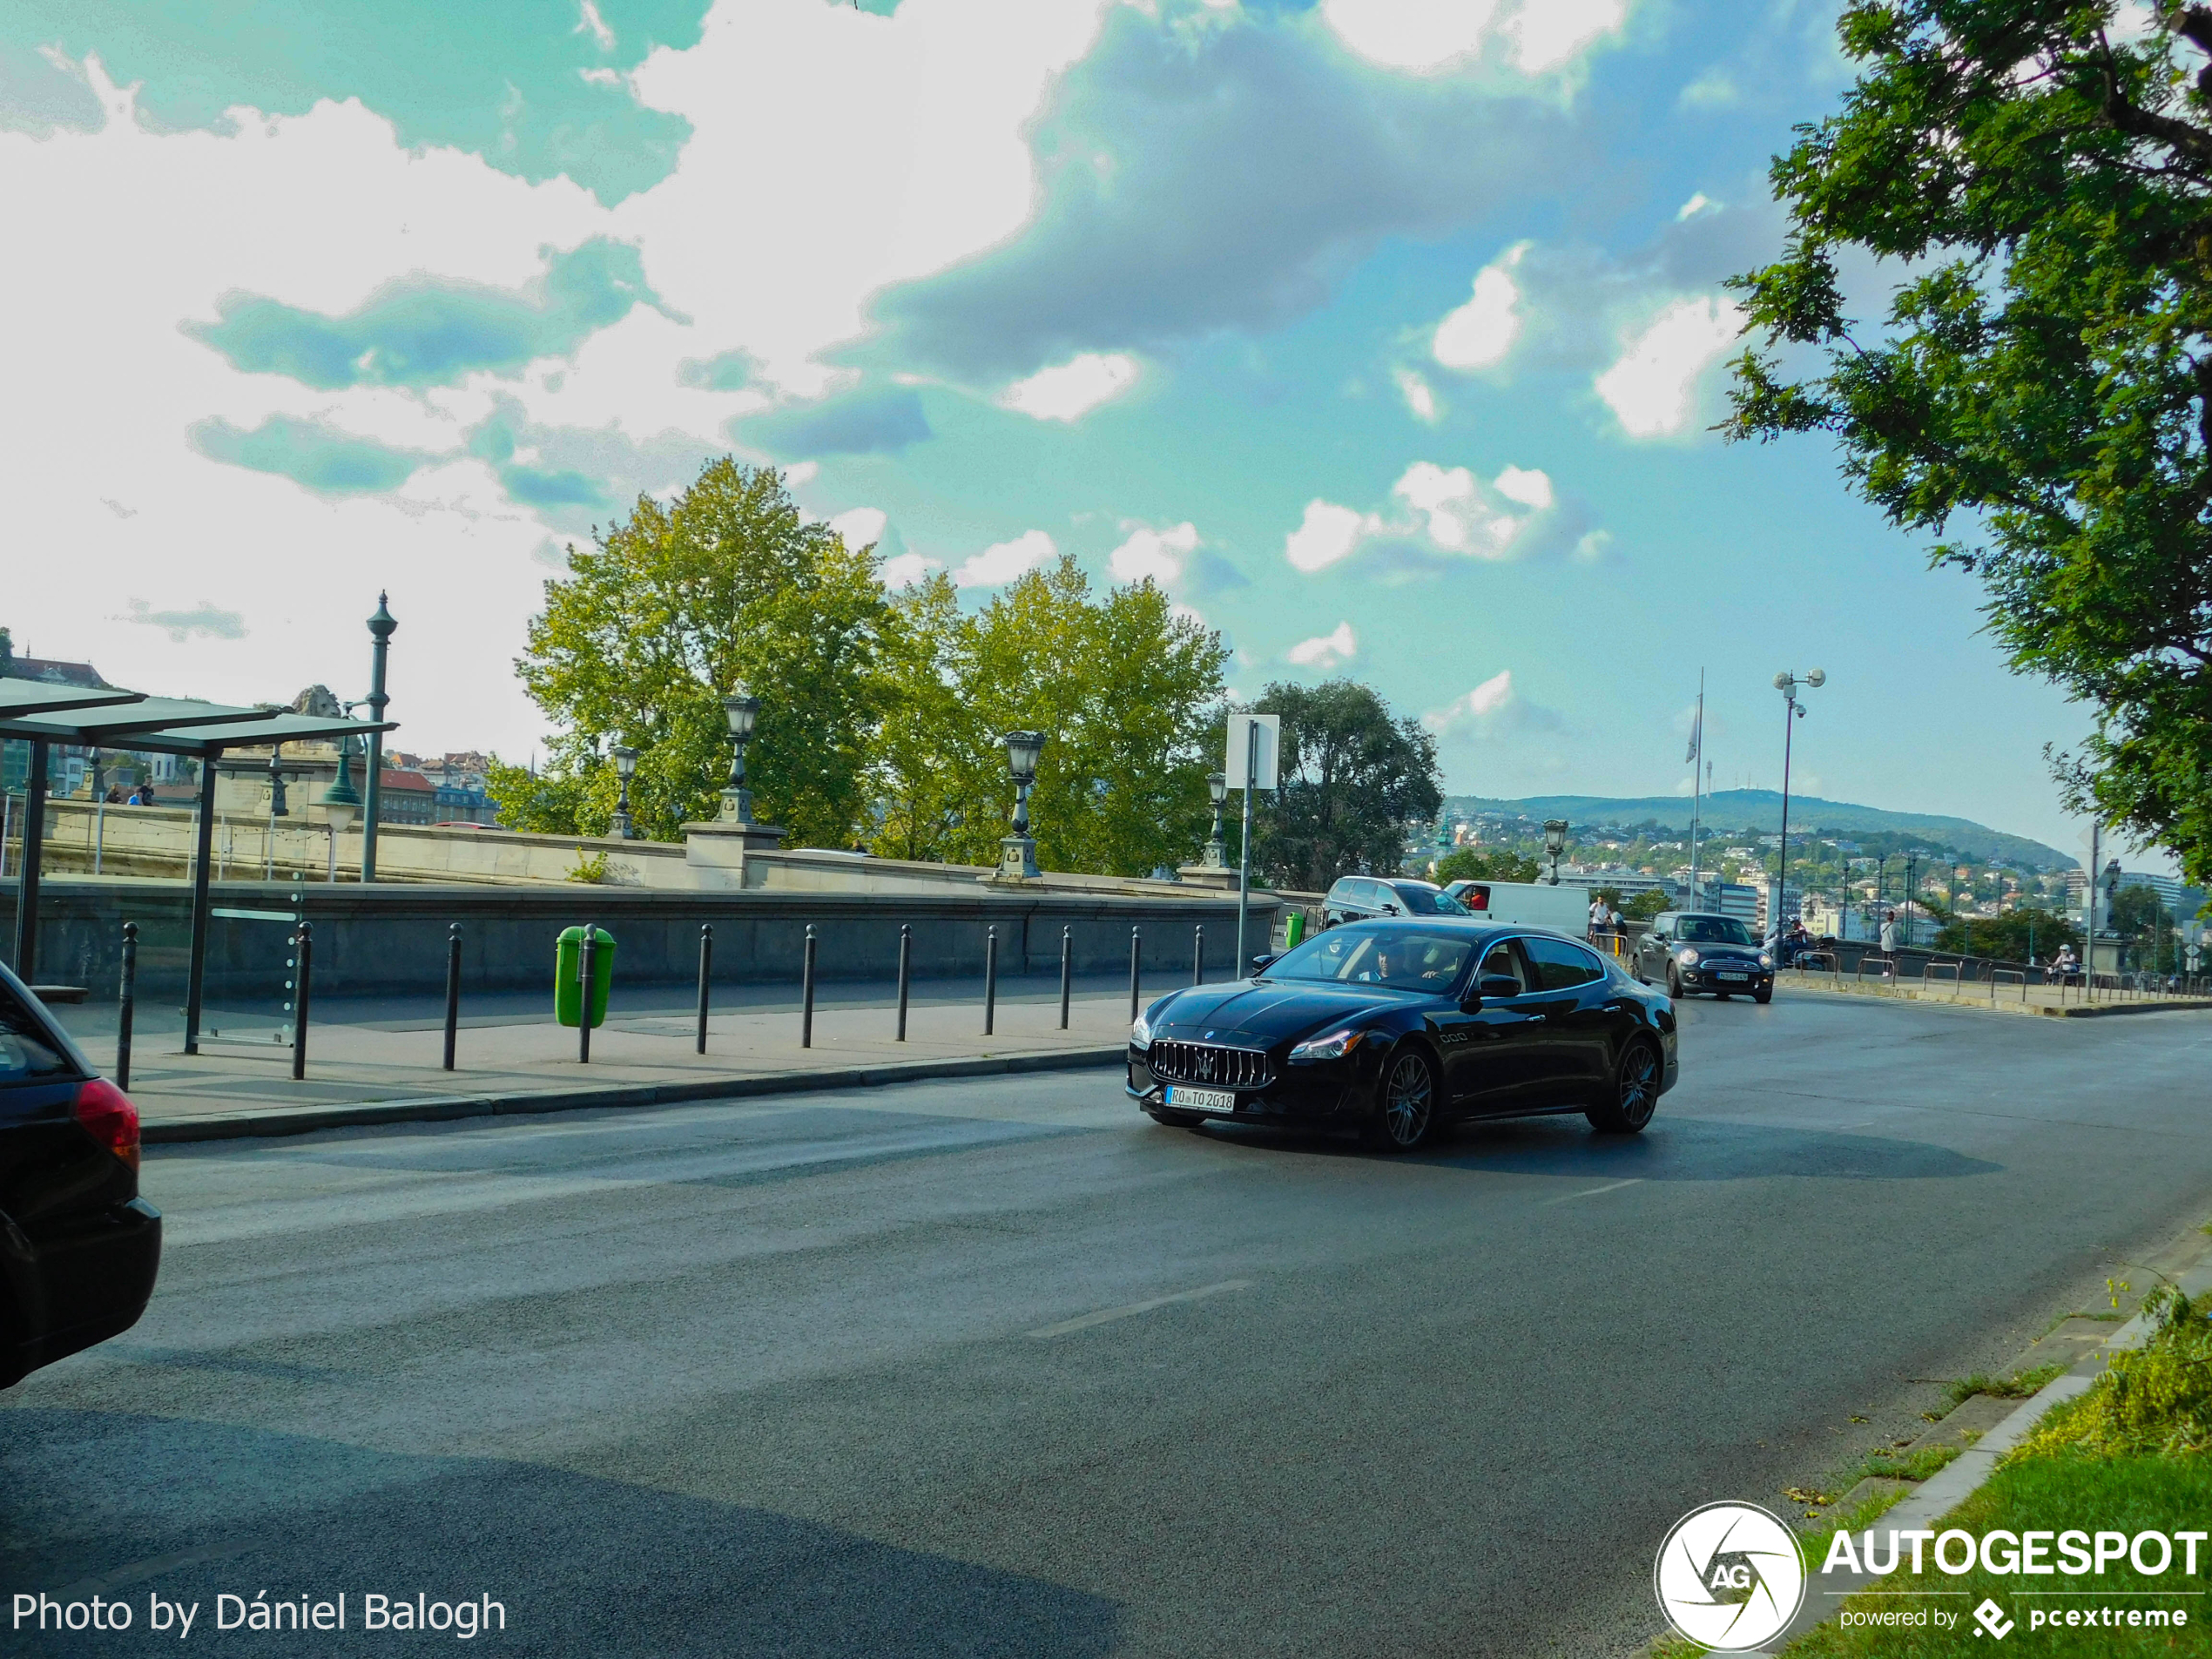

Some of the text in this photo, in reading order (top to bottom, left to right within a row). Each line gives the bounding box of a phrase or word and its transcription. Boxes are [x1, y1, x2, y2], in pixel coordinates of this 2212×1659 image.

[1172, 1089, 1185, 1103] RO
[1193, 1091, 1205, 1105] TO
[1206, 1093, 1233, 1109] 2018
